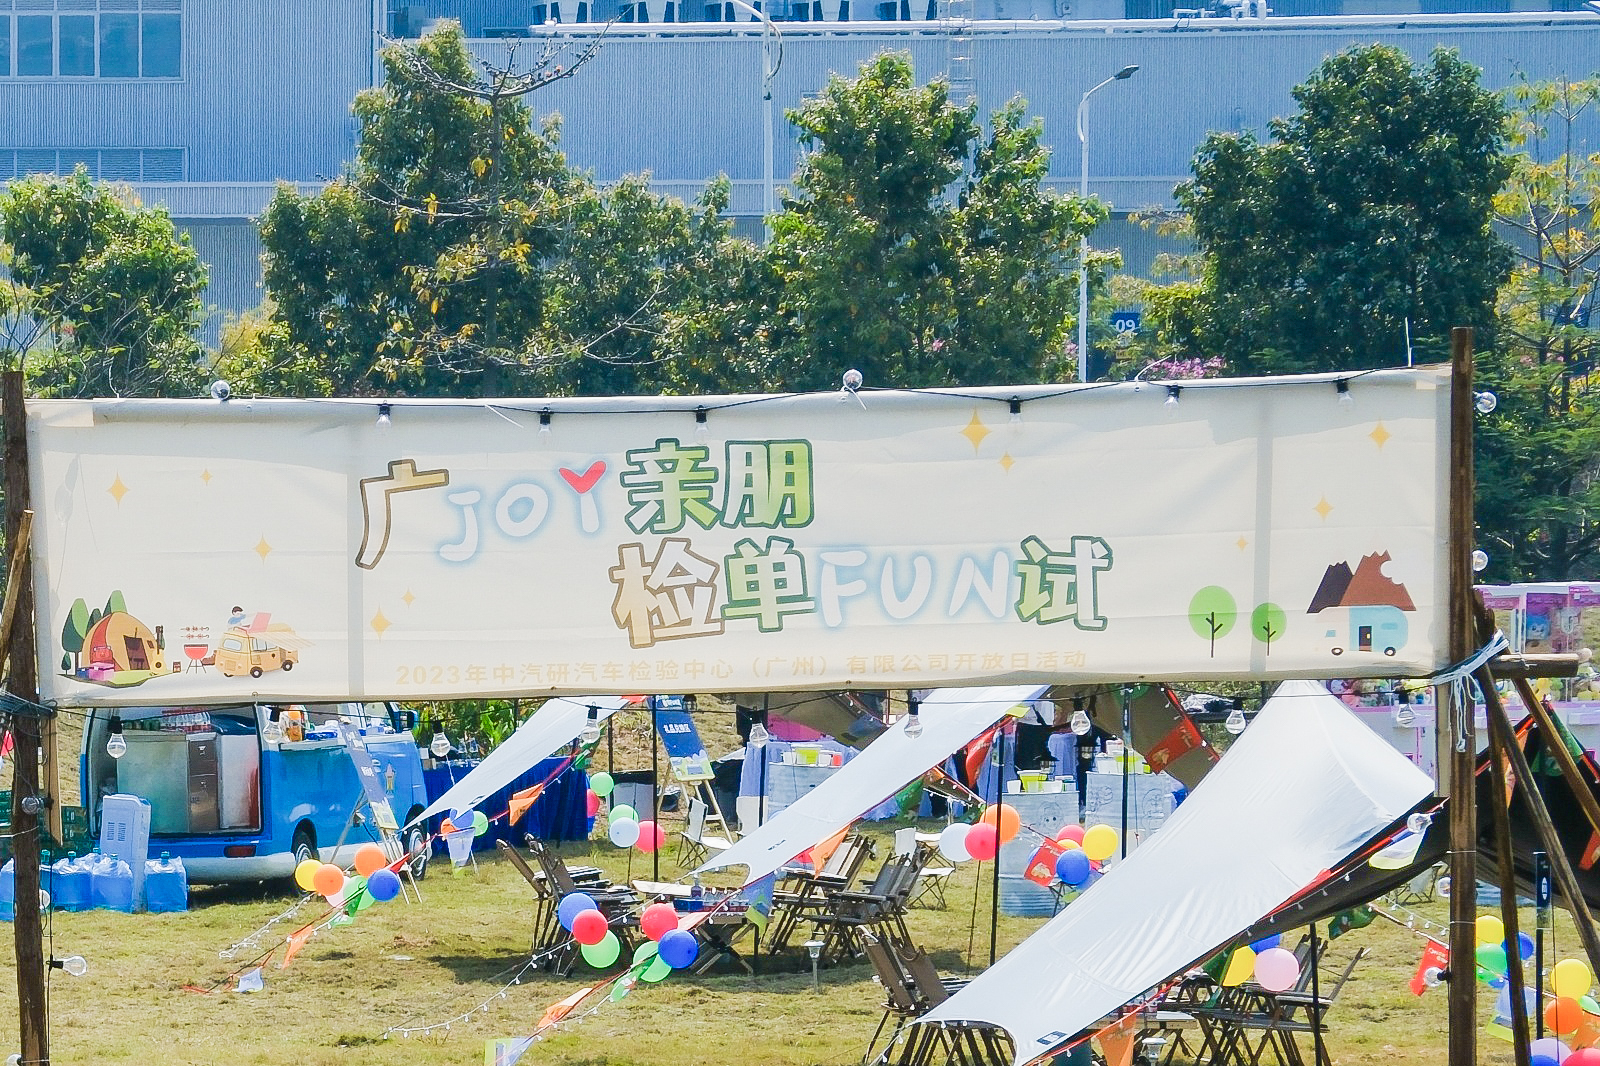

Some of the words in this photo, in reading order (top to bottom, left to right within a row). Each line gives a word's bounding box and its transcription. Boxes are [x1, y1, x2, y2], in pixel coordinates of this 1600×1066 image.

[1115, 319, 1136, 333] 09
[608, 534, 1115, 649] 检单FUN试
